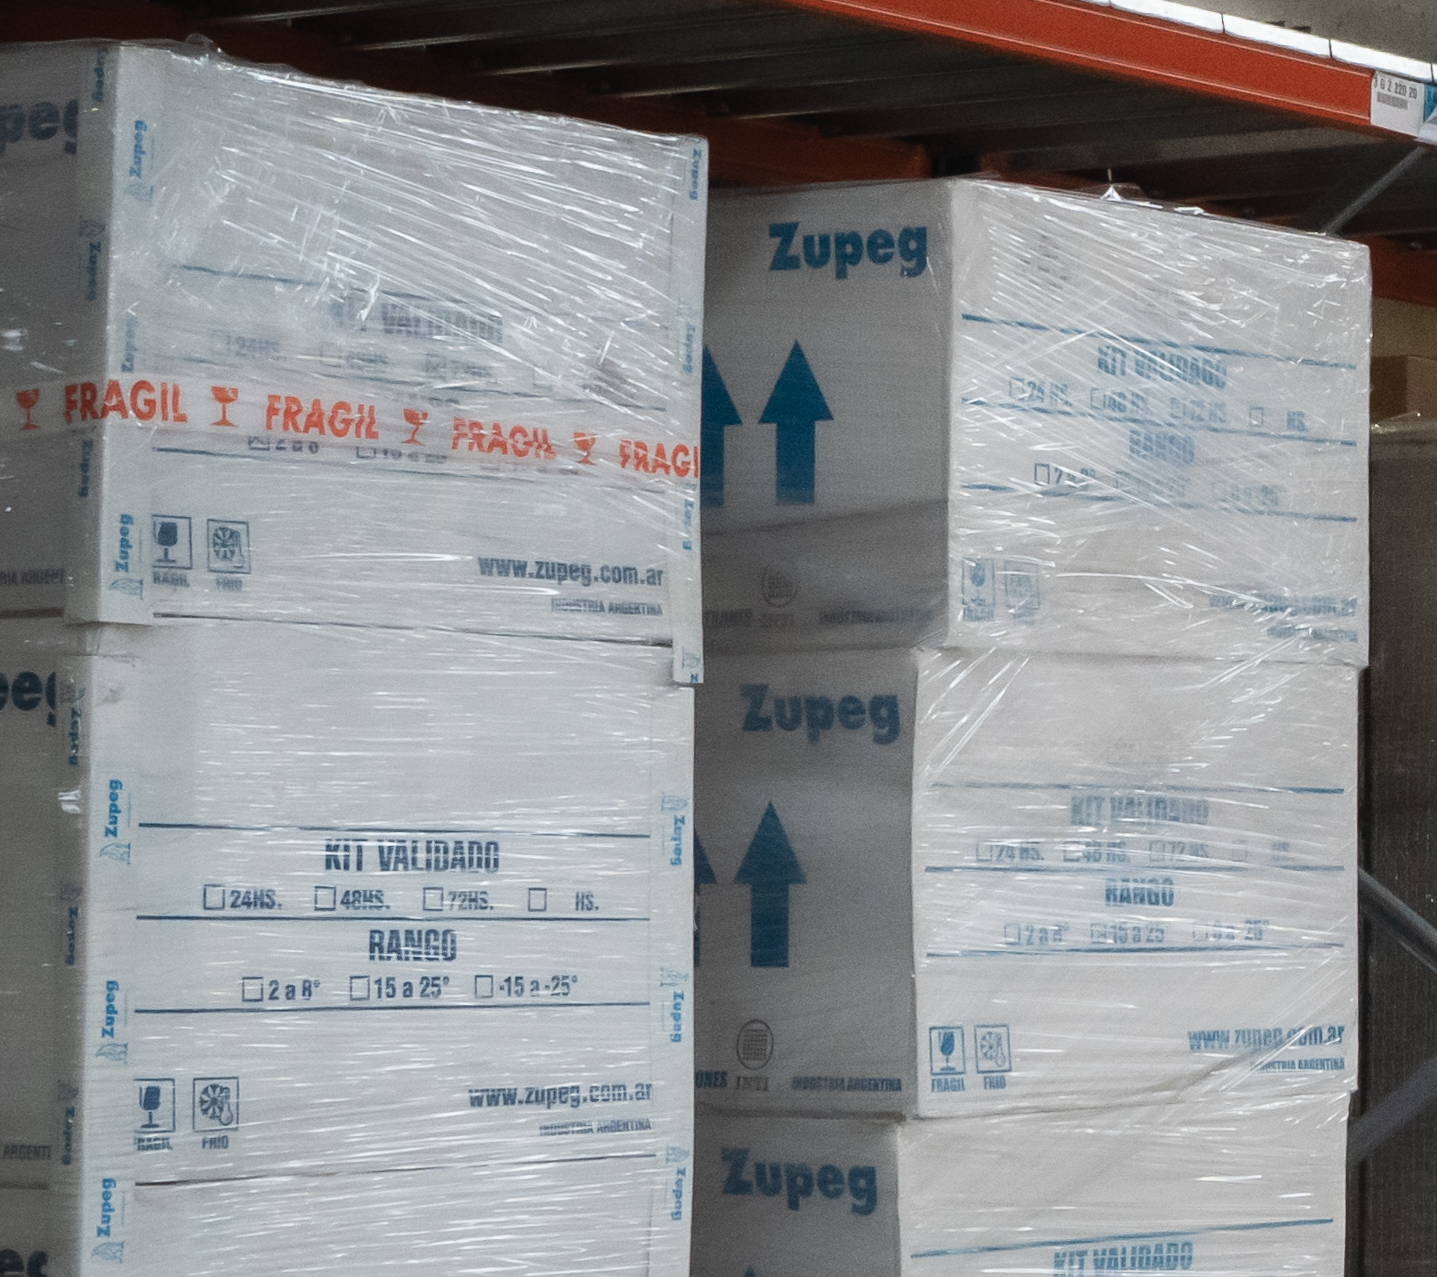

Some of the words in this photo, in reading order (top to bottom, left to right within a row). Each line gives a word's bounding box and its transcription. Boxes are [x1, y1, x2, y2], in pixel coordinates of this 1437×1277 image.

[767, 222, 928, 280] Zupeg
[63, 379, 188, 424] FRAGIL
[265, 393, 379, 441] FRAGIL
[451, 416, 556, 461] FRAGIL
[115, 514, 133, 573] Zupeg
[478, 556, 664, 587] www.zupeg.com.ar
[608, 599, 663, 617] ARGENTINA
[739, 684, 900, 745] Zupeg
[104, 779, 122, 838] Zupeg
[324, 839, 368, 872] KIT
[378, 839, 500, 873] VALIDADO
[670, 814, 686, 867] Zupeg
[229, 890, 283, 910] 24HS.
[340, 889, 391, 910] 48HS.
[448, 890, 494, 911] 72HS.
[574, 891, 600, 912] HS.
[1104, 877, 1175, 907] RANGO
[368, 929, 457, 962] RANGO
[268, 980, 280, 1001] 2
[285, 984, 296, 1000] a
[374, 979, 397, 1000] 15
[402, 984, 413, 998] a
[419, 976, 450, 999] 25°
[530, 980, 540, 996] a
[102, 980, 119, 1038] Zupeg
[670, 990, 685, 1043] Zupeg
[468, 1082, 653, 1110] www.zupeg.com.ar
[847, 1077, 902, 1093] ARGENTINA
[931, 1076, 966, 1093] FRAGIL
[202, 1135, 229, 1149] FRIO
[596, 1118, 652, 1134] ARGENTINA
[720, 1147, 878, 1216] Zupeg
[96, 1178, 116, 1238] Zupeg
[1093, 1241, 1194, 1273] VALIDADO
